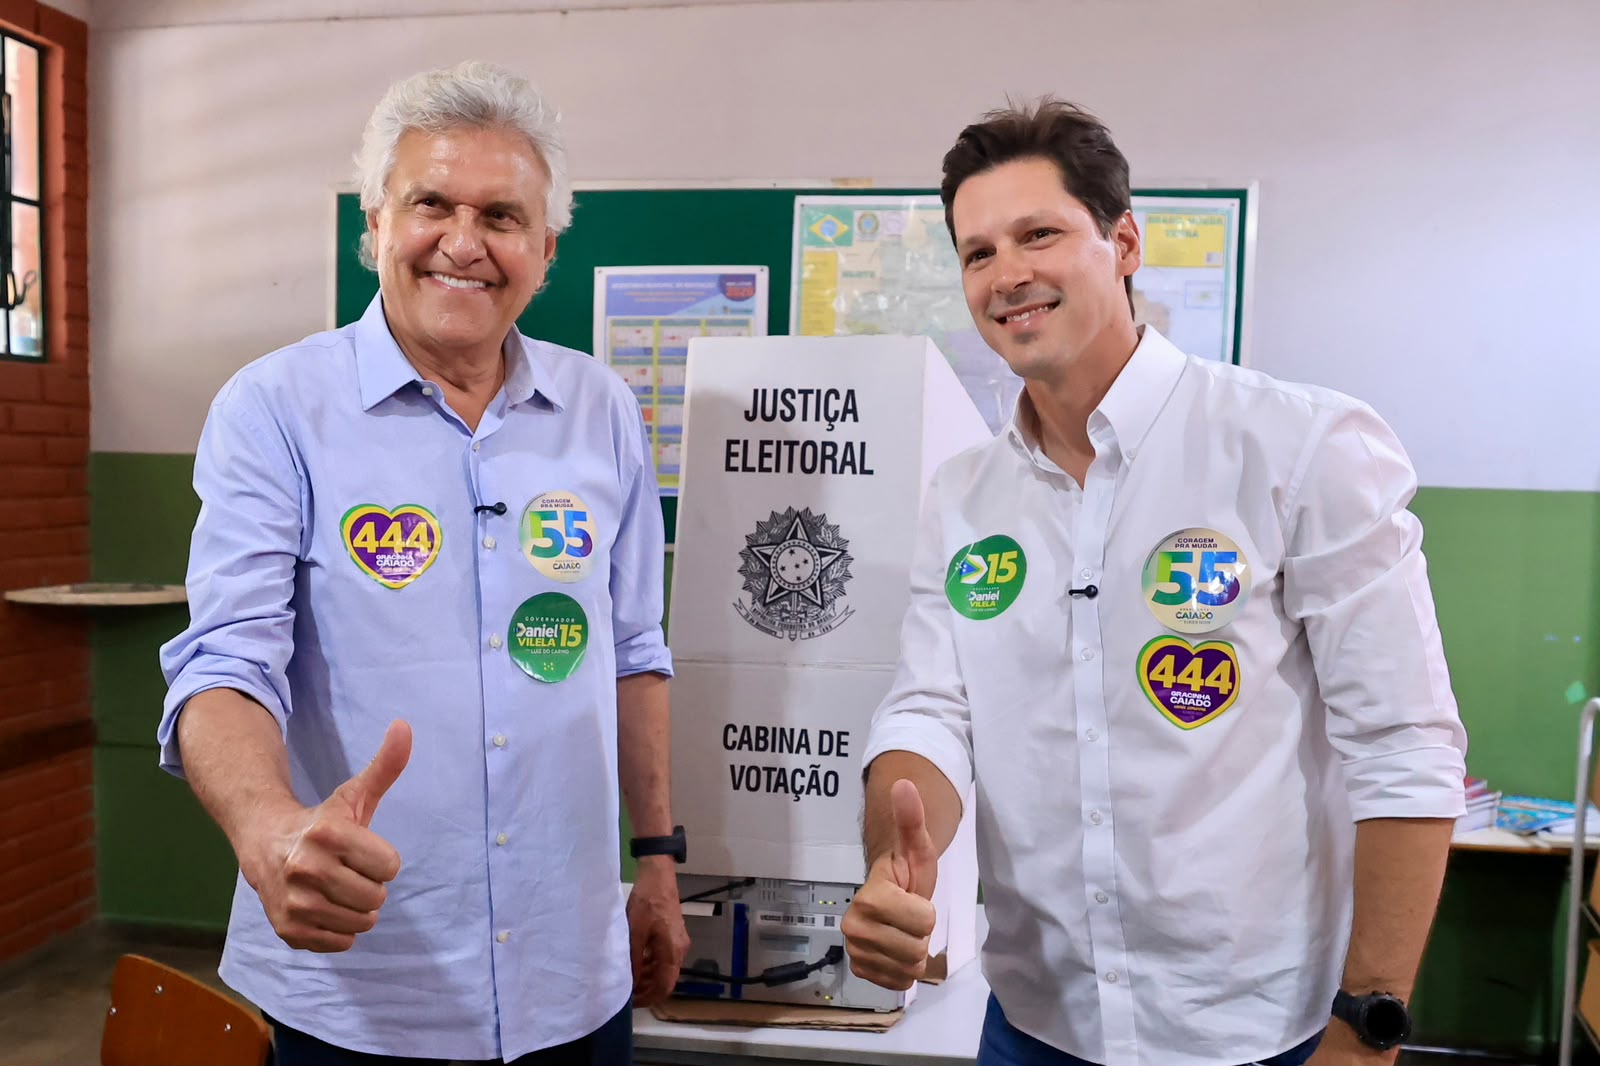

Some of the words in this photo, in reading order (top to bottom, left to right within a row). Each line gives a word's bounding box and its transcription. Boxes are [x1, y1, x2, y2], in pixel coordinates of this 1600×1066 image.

[744, 388, 859, 431] JUSTIÇA
[725, 439, 874, 475] ELEITORAL
[352, 521, 432, 553] 444
[529, 510, 593, 558] 55
[552, 562, 581, 570] CAIADO
[987, 550, 1018, 584] 15
[1152, 551, 1240, 606] 55
[968, 590, 1000, 601] Daniel
[515, 622, 558, 638] Daniel
[1175, 611, 1214, 620] CAIADO
[517, 638, 556, 647] VILELA
[559, 624, 583, 647] 15
[1149, 654, 1233, 695] 444
[1170, 690, 1211, 700] GRACINHA
[1170, 696, 1211, 708] CAIADO
[722, 723, 811, 755] CABINA
[818, 730, 850, 757] DE
[729, 764, 839, 802] VOTAÇÃO
